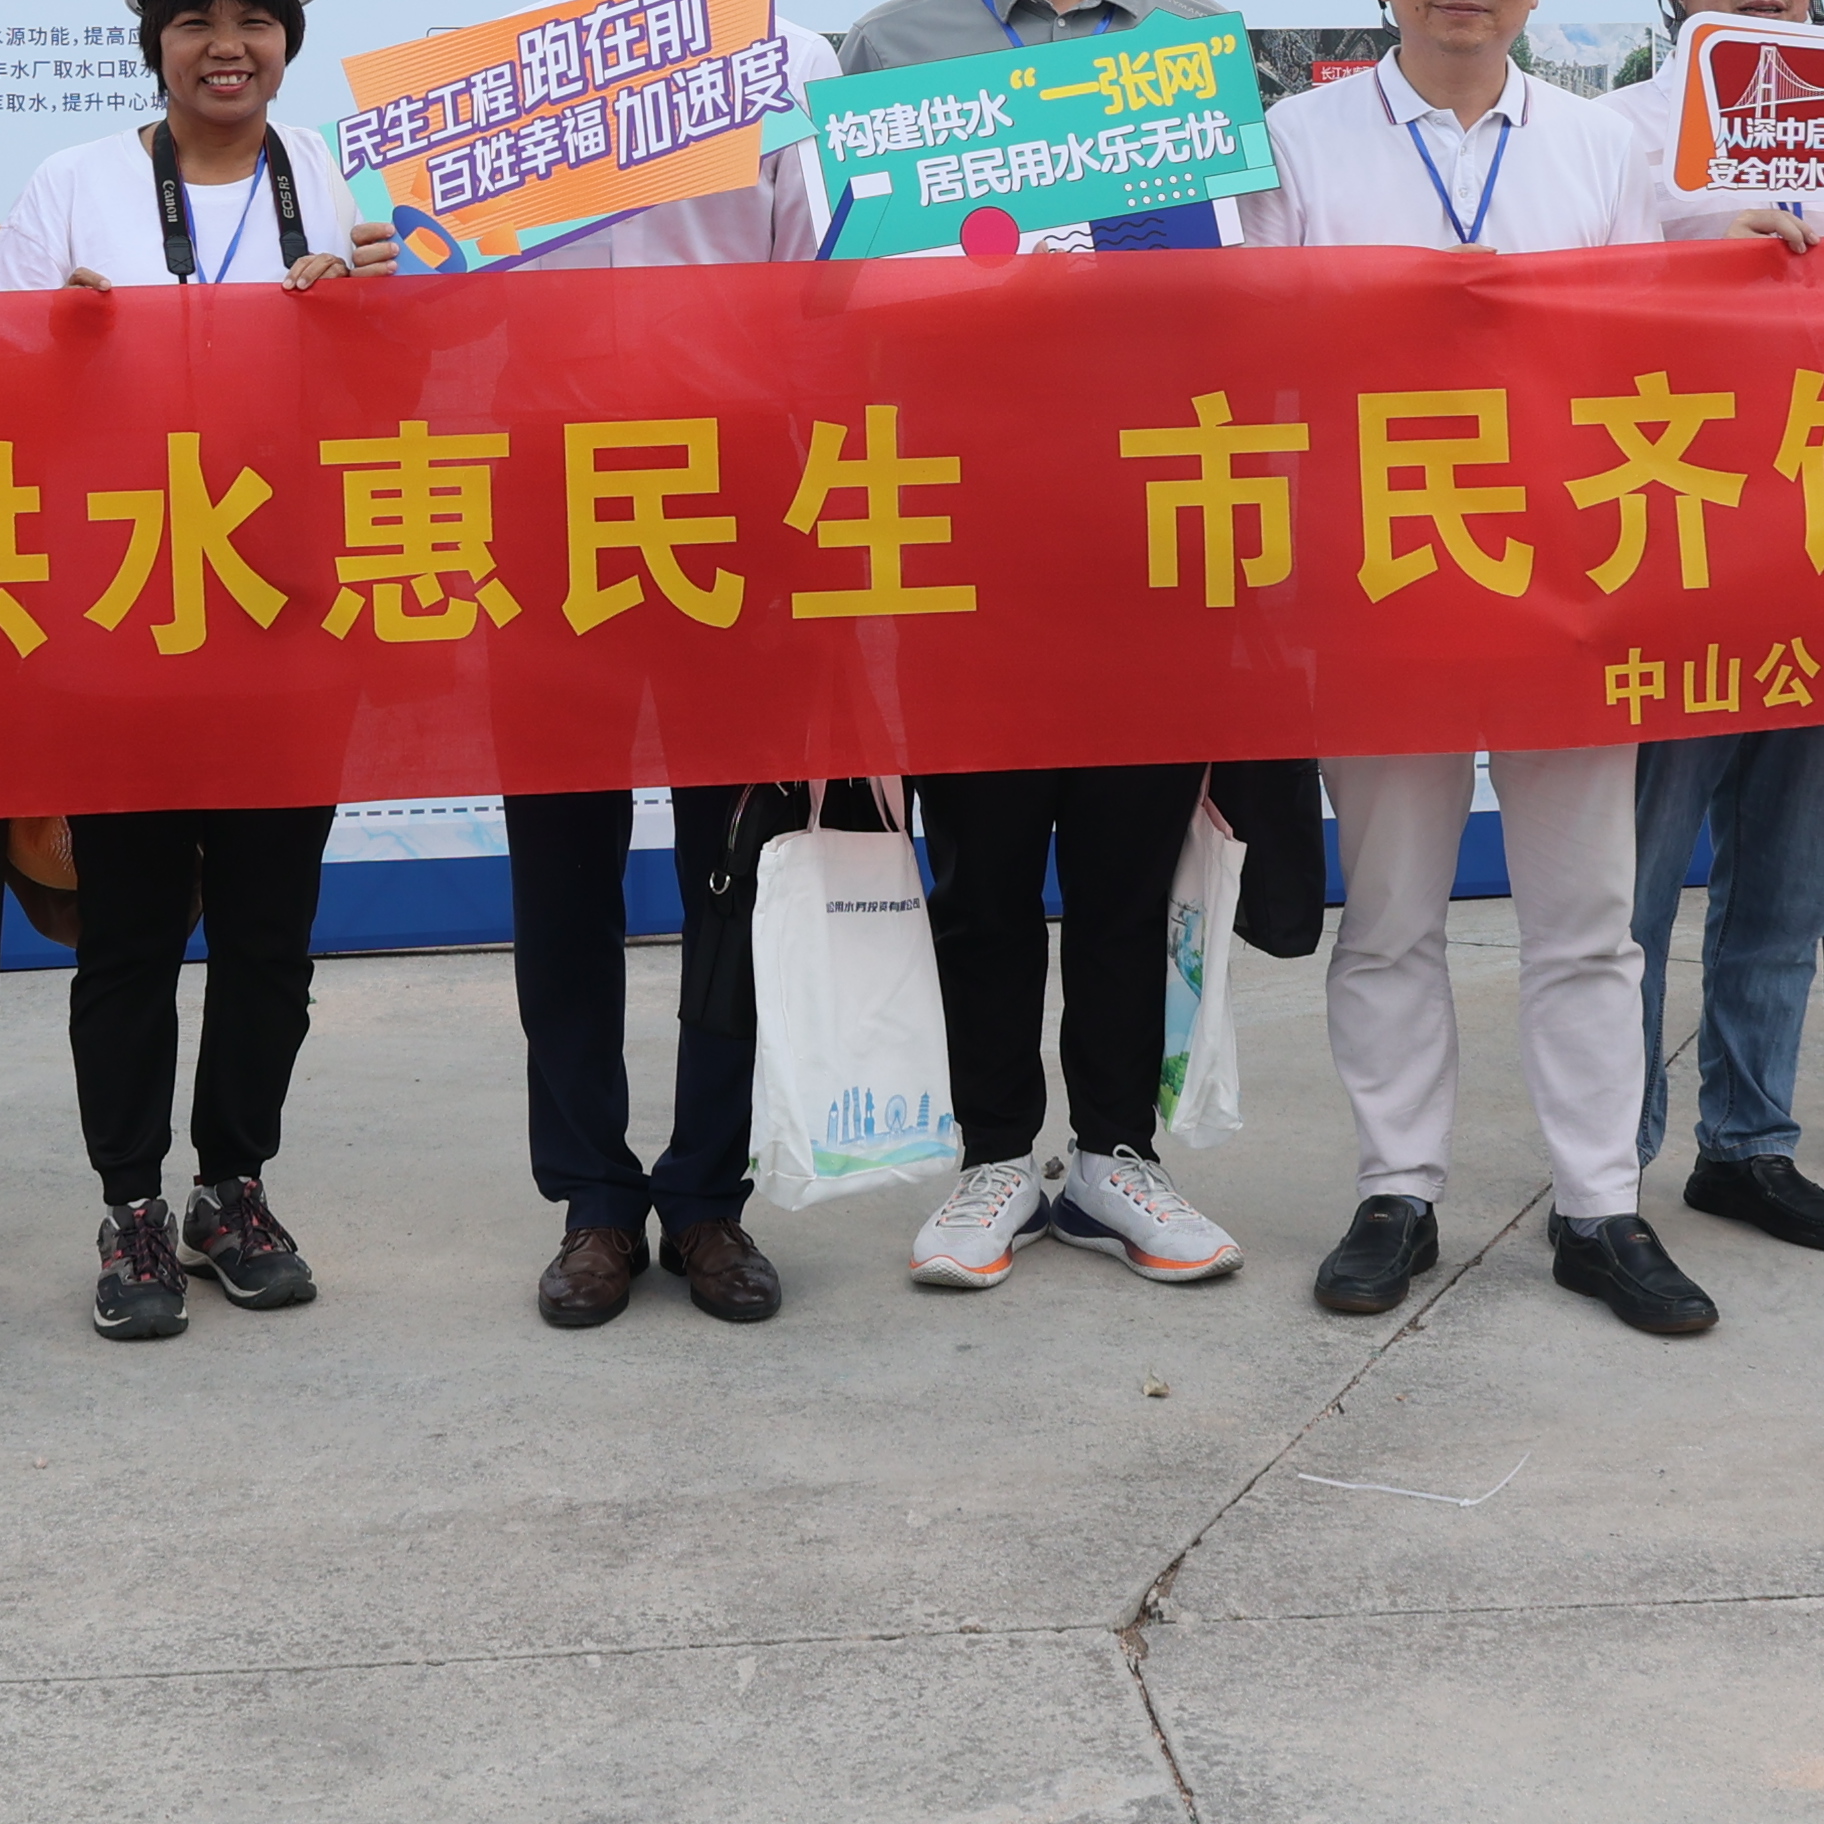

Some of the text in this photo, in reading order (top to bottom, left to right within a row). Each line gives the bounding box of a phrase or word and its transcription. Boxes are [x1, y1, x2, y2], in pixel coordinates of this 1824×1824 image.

[916, 109, 1236, 207] 居民用水乐无忧
[162, 179, 178, 223] Canon
[277, 175, 295, 219] EOS R5
